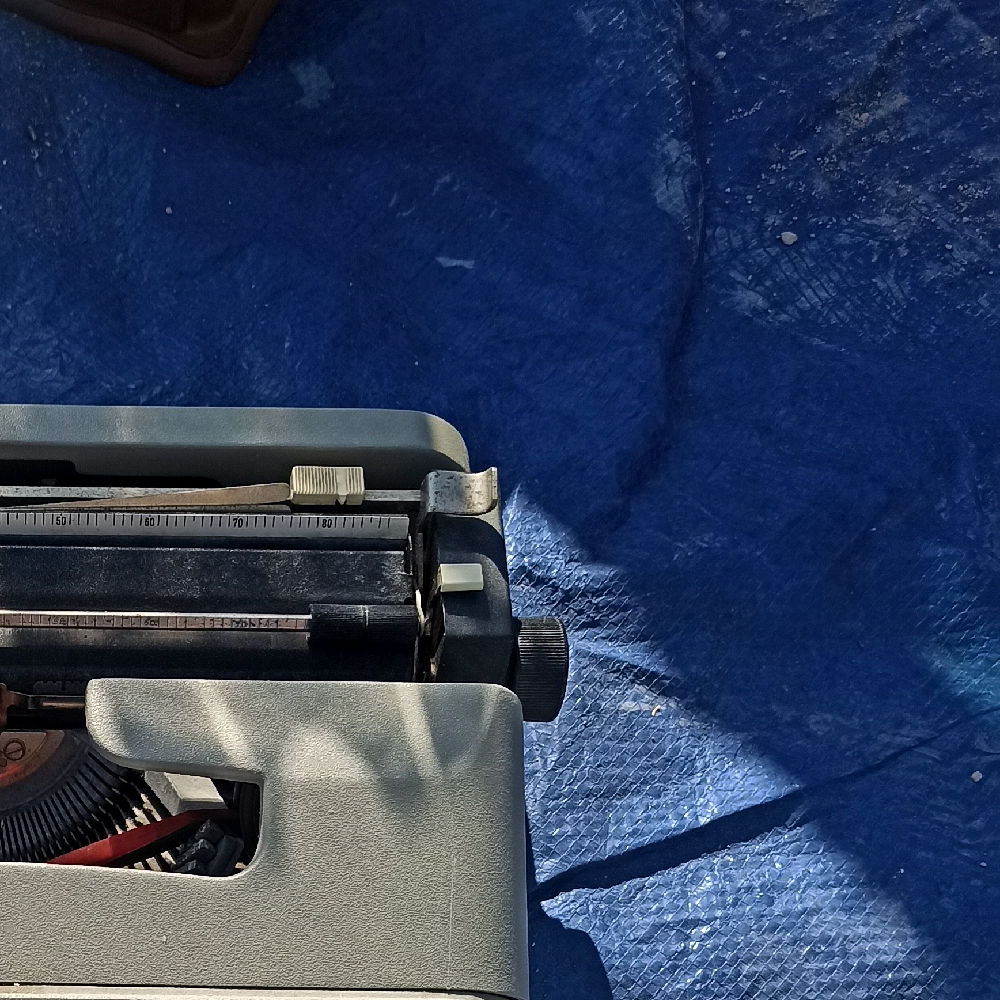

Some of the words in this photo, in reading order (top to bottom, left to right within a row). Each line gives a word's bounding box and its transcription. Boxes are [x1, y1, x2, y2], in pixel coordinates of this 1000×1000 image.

[55, 515, 67, 526] 50
[144, 516, 155, 527] 60
[232, 517, 243, 529] 70
[321, 517, 333, 529] 80
